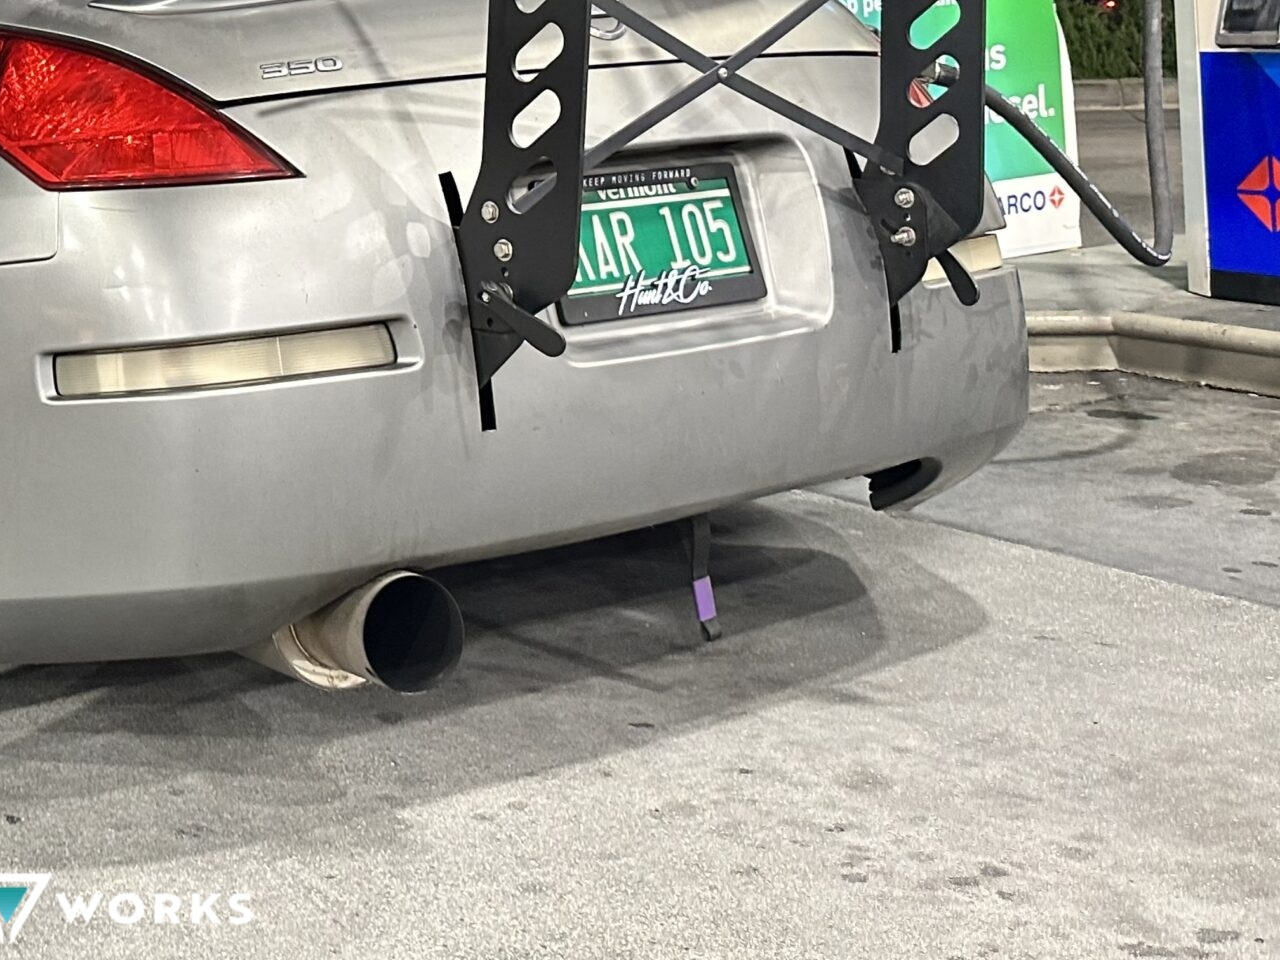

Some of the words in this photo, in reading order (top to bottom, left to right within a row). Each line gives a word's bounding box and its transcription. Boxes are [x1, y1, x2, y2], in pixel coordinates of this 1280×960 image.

[259, 56, 343, 80] 350
[582, 176, 606, 187] KEEP
[611, 172, 646, 185] MOVING
[652, 168, 691, 180] FORWARD
[659, 200, 736, 269] 105
